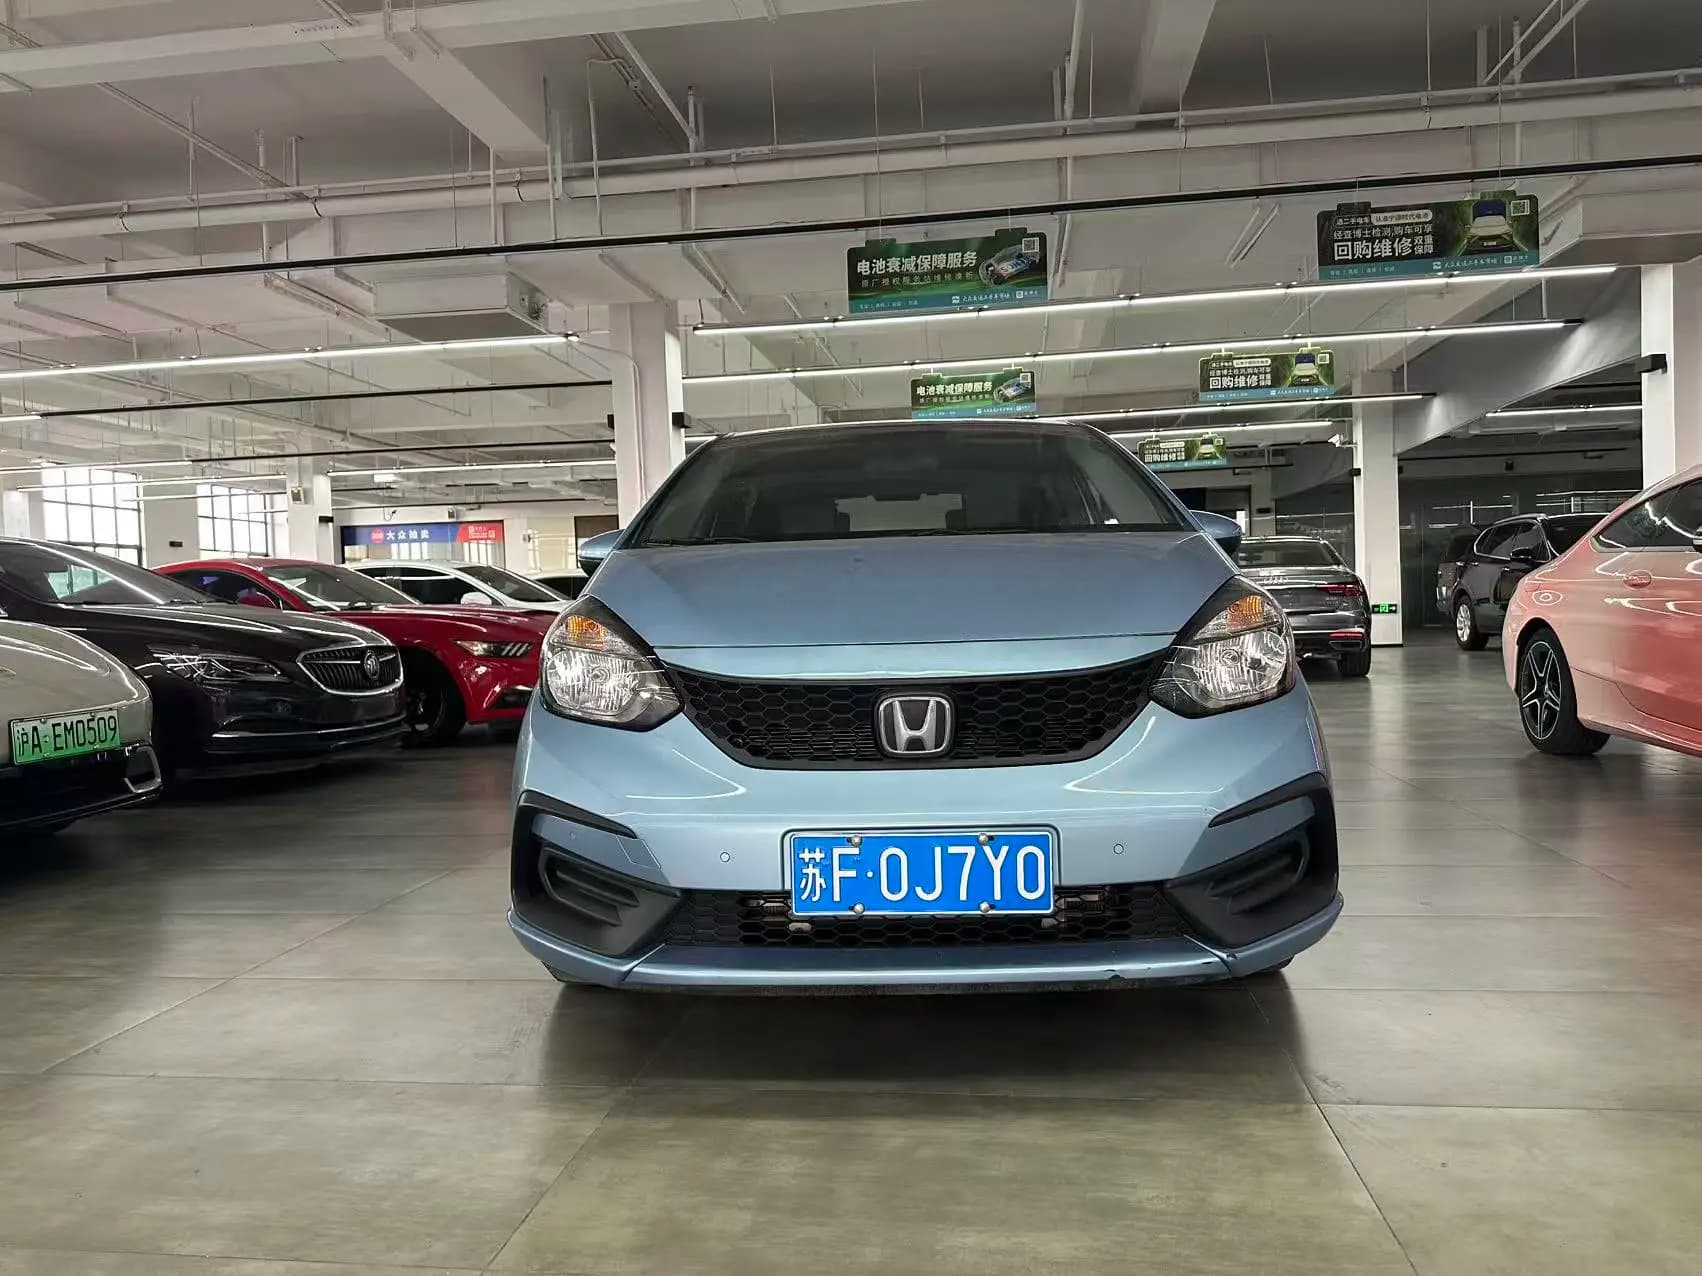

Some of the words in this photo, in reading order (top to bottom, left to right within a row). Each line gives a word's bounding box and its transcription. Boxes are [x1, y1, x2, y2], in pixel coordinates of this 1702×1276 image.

[1334, 237, 1413, 260] 回购维修
[1413, 245, 1434, 255] 保障
[856, 250, 978, 276] 电池衰减保障服务
[916, 381, 993, 396] 电池衰减保障服务
[1209, 374, 1259, 389] 回购维修
